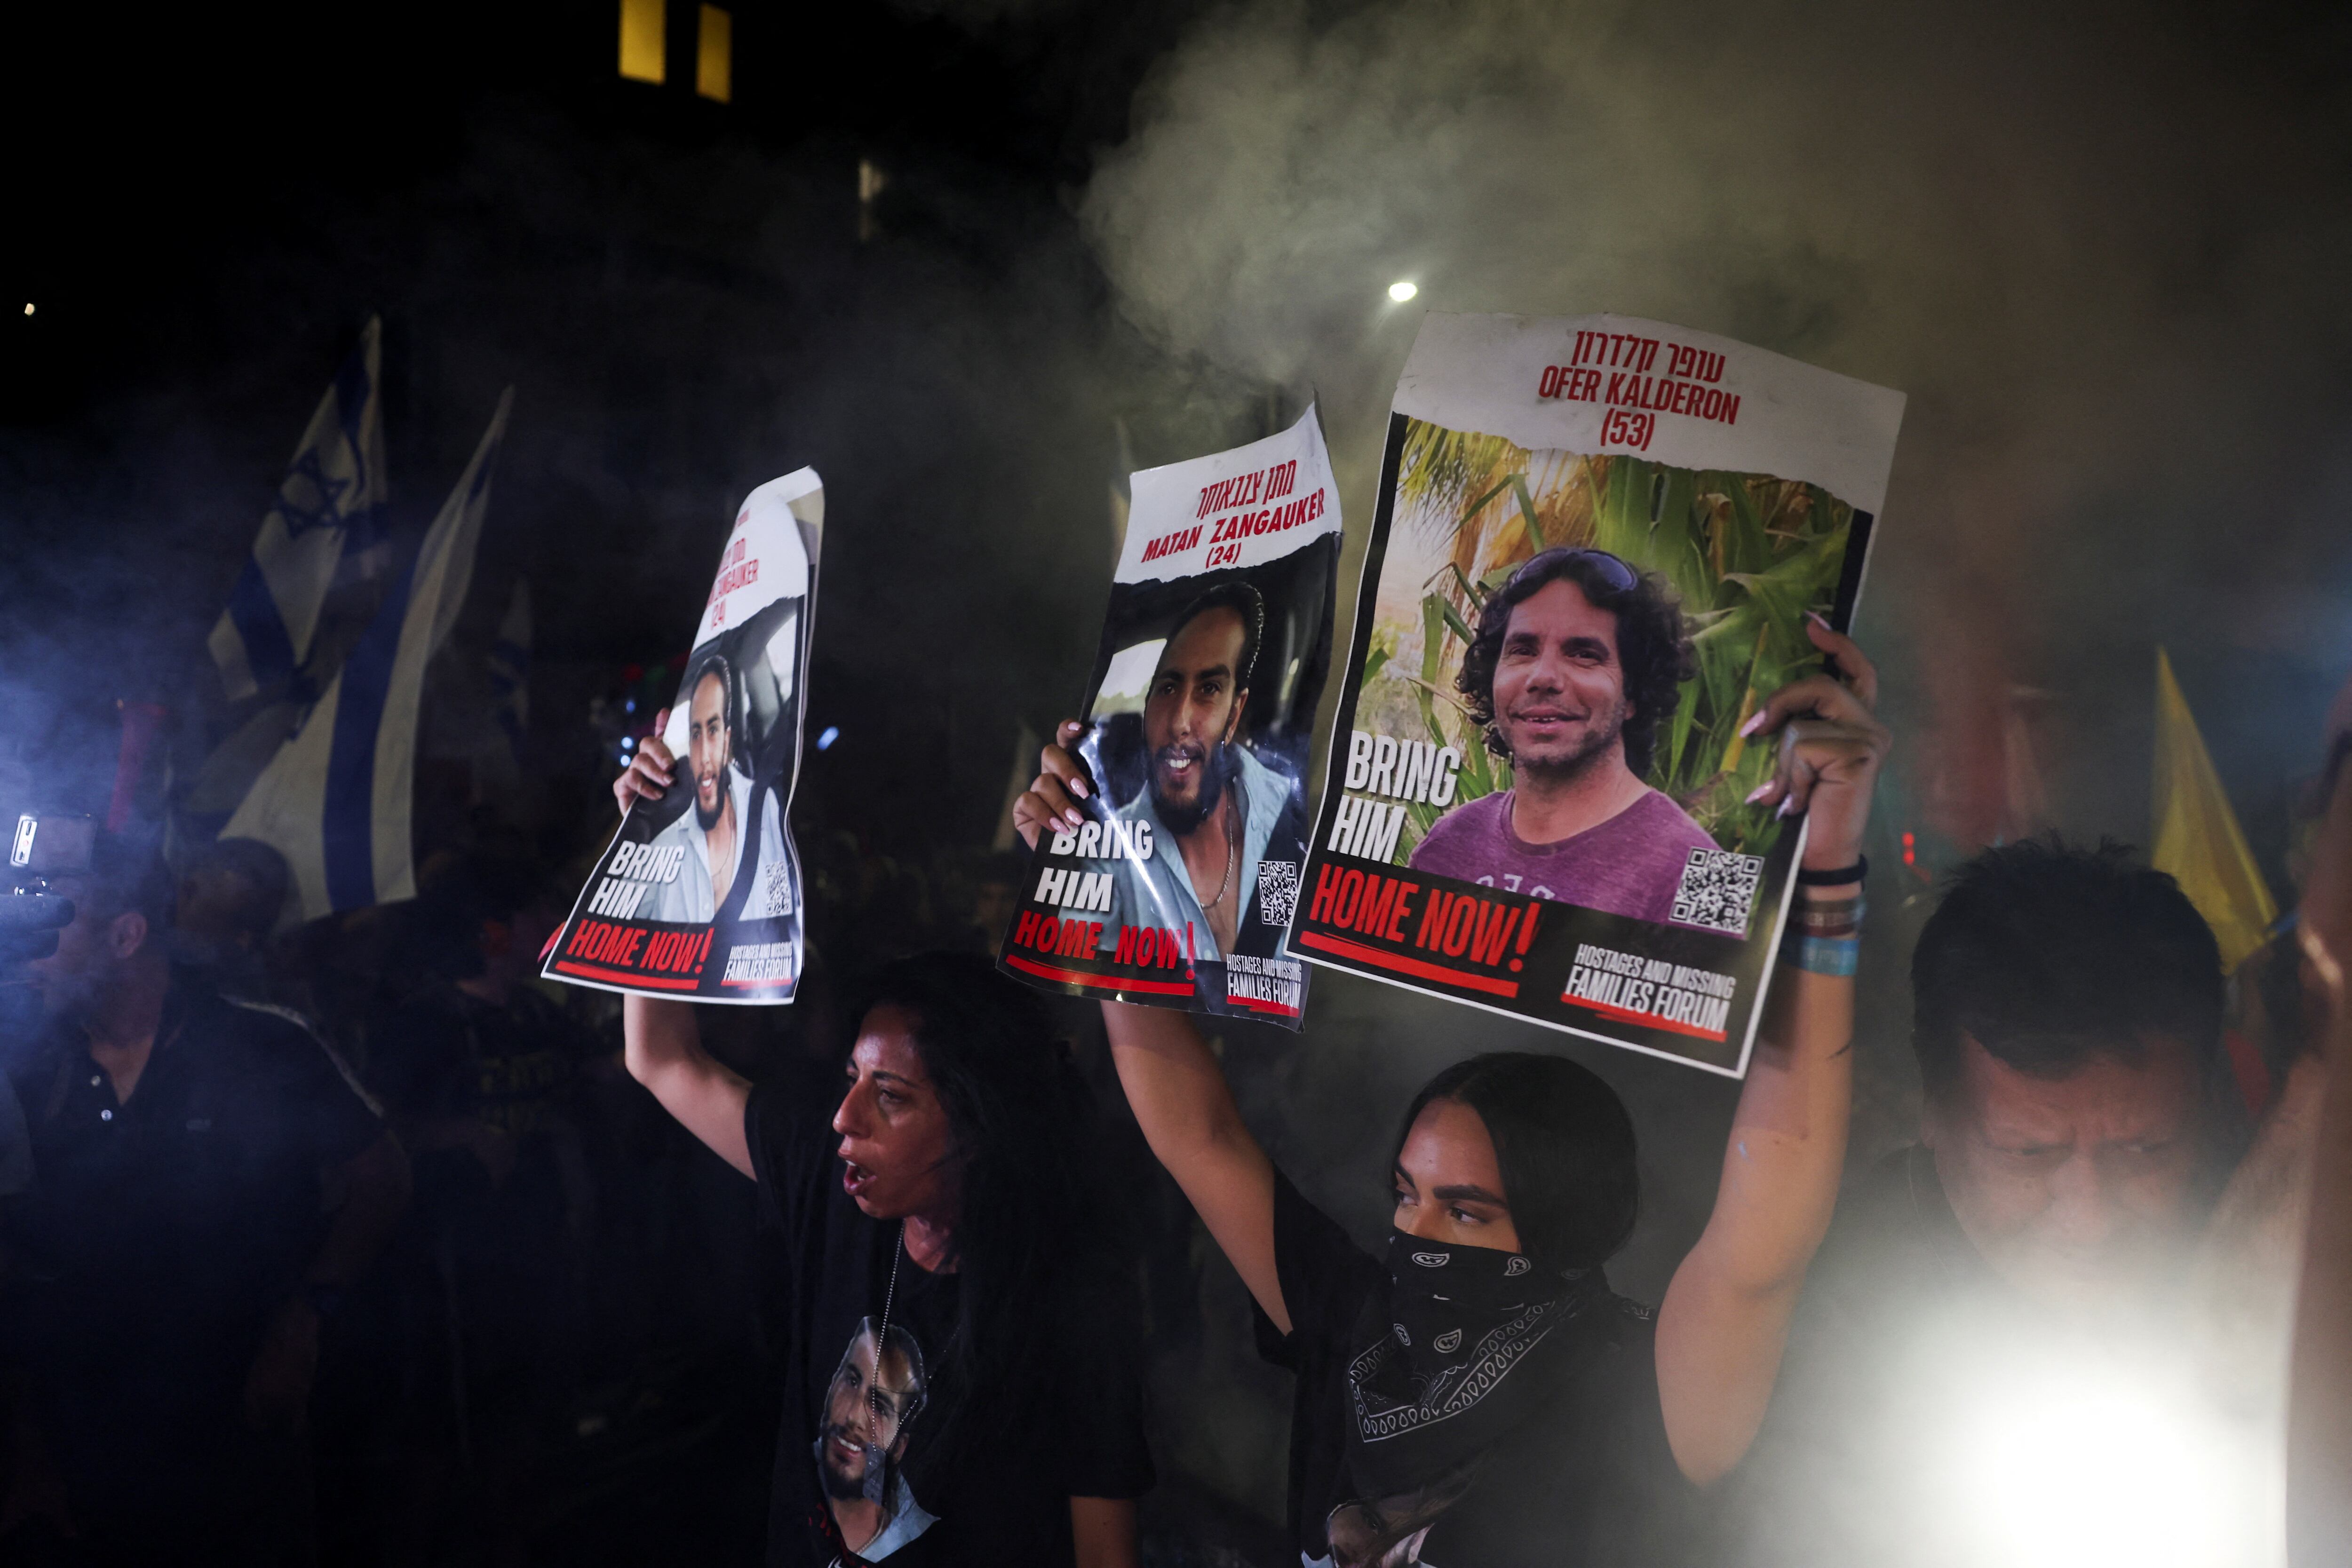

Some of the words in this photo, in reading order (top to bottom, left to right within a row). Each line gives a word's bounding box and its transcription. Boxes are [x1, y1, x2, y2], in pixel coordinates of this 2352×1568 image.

[1571, 331, 1659, 373] קלדרון
[1667, 343, 1725, 383] עופר
[1539, 365, 1602, 402] OFER
[1605, 372, 1740, 425] KALDERON
[1600, 408, 1655, 451] (53)
[1263, 459, 1296, 505] מתן
[1141, 525, 1203, 563] MATAN
[1208, 487, 1324, 544] ZANGAUKER
[1206, 542, 1242, 569] (24)
[1345, 729, 1461, 807] BRING
[1049, 819, 1153, 860] BRING
[1327, 795, 1406, 864] HIM
[607, 840, 684, 883] BRING
[588, 877, 647, 920] HIM
[1033, 867, 1113, 912] HIM
[1309, 863, 1420, 943] HOME
[1415, 888, 1542, 973] NOW!
[566, 919, 647, 967] HOME
[639, 927, 715, 974] NOW!
[729, 945, 760, 961] HOSTAGES
[758, 943, 771, 960] AND
[770, 941, 793, 959] MISSING
[1013, 910, 1103, 960] HOME
[1114, 921, 1195, 980] NOW!
[723, 959, 765, 982] FAMILIES
[764, 956, 793, 981] FORUM
[1226, 953, 1261, 975] HOSTAGES
[1262, 958, 1275, 977] AND
[1275, 959, 1302, 983] MISSING
[1574, 943, 1645, 978] HOSTAGES
[1641, 958, 1673, 984] AND
[1668, 965, 1737, 1000] MISSING
[1227, 972, 1272, 1002] FAMILIES
[1272, 978, 1302, 1009] FORUM
[1565, 965, 1654, 1014] FAMILIES
[1652, 986, 1731, 1034] FORUM
